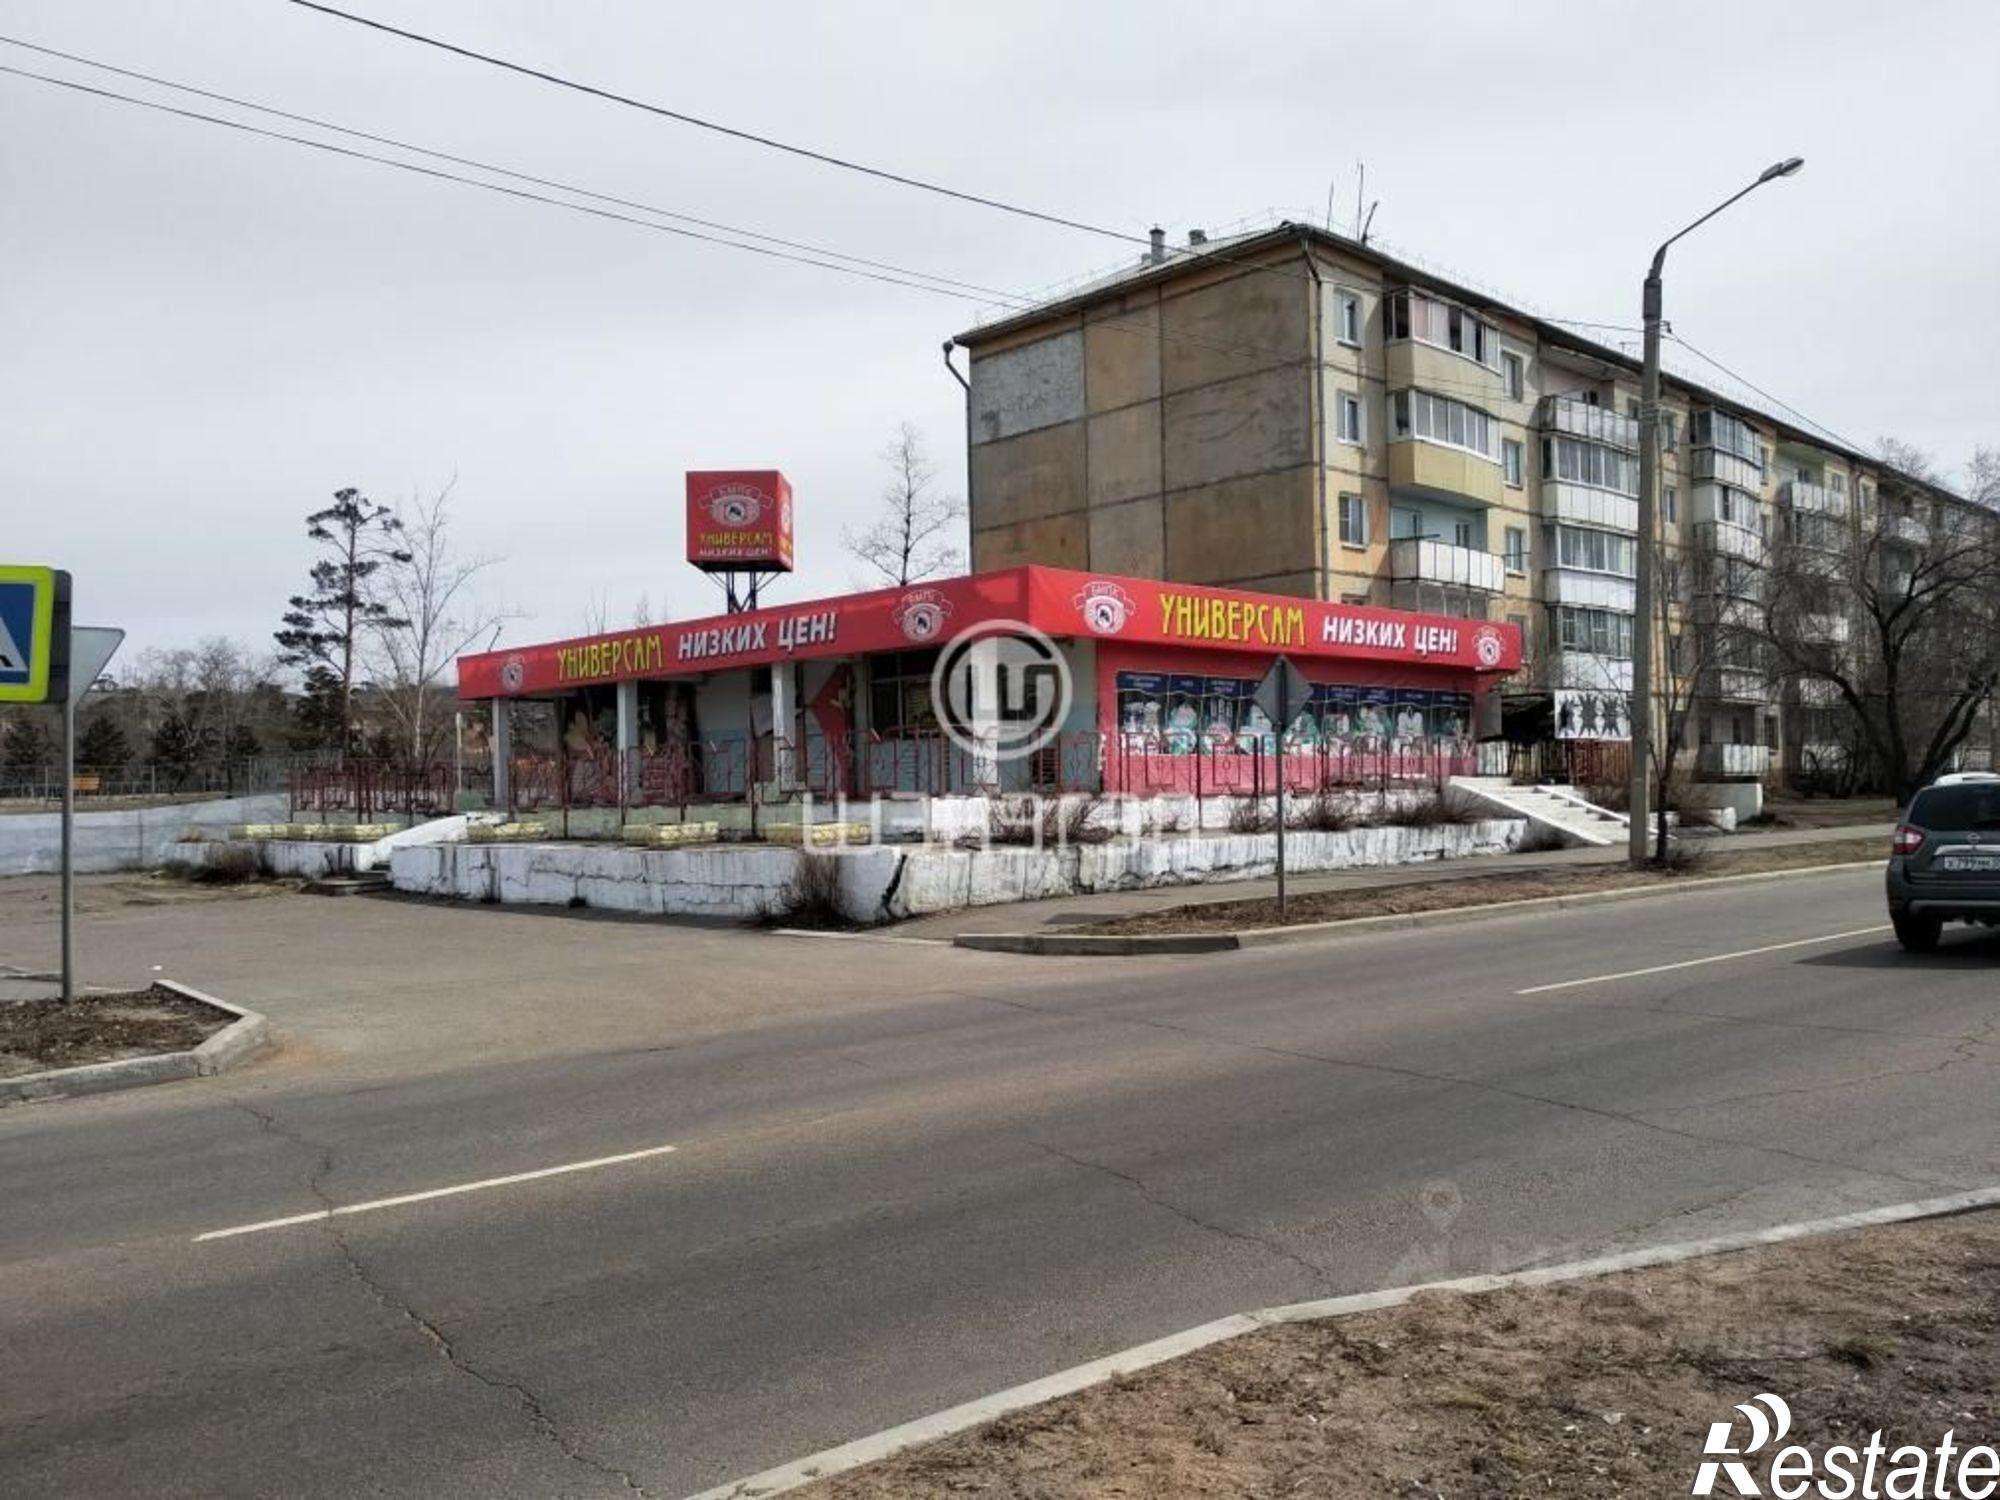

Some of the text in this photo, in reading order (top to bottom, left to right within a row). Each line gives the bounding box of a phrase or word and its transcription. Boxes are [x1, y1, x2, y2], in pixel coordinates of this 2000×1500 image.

[556, 612, 837, 681] УНИВЕРСАМ НИЗКИХ ЦЕН!
[1159, 593, 1458, 655] УНИВЕРСАМ НИЗКИХ ЦЕН!
